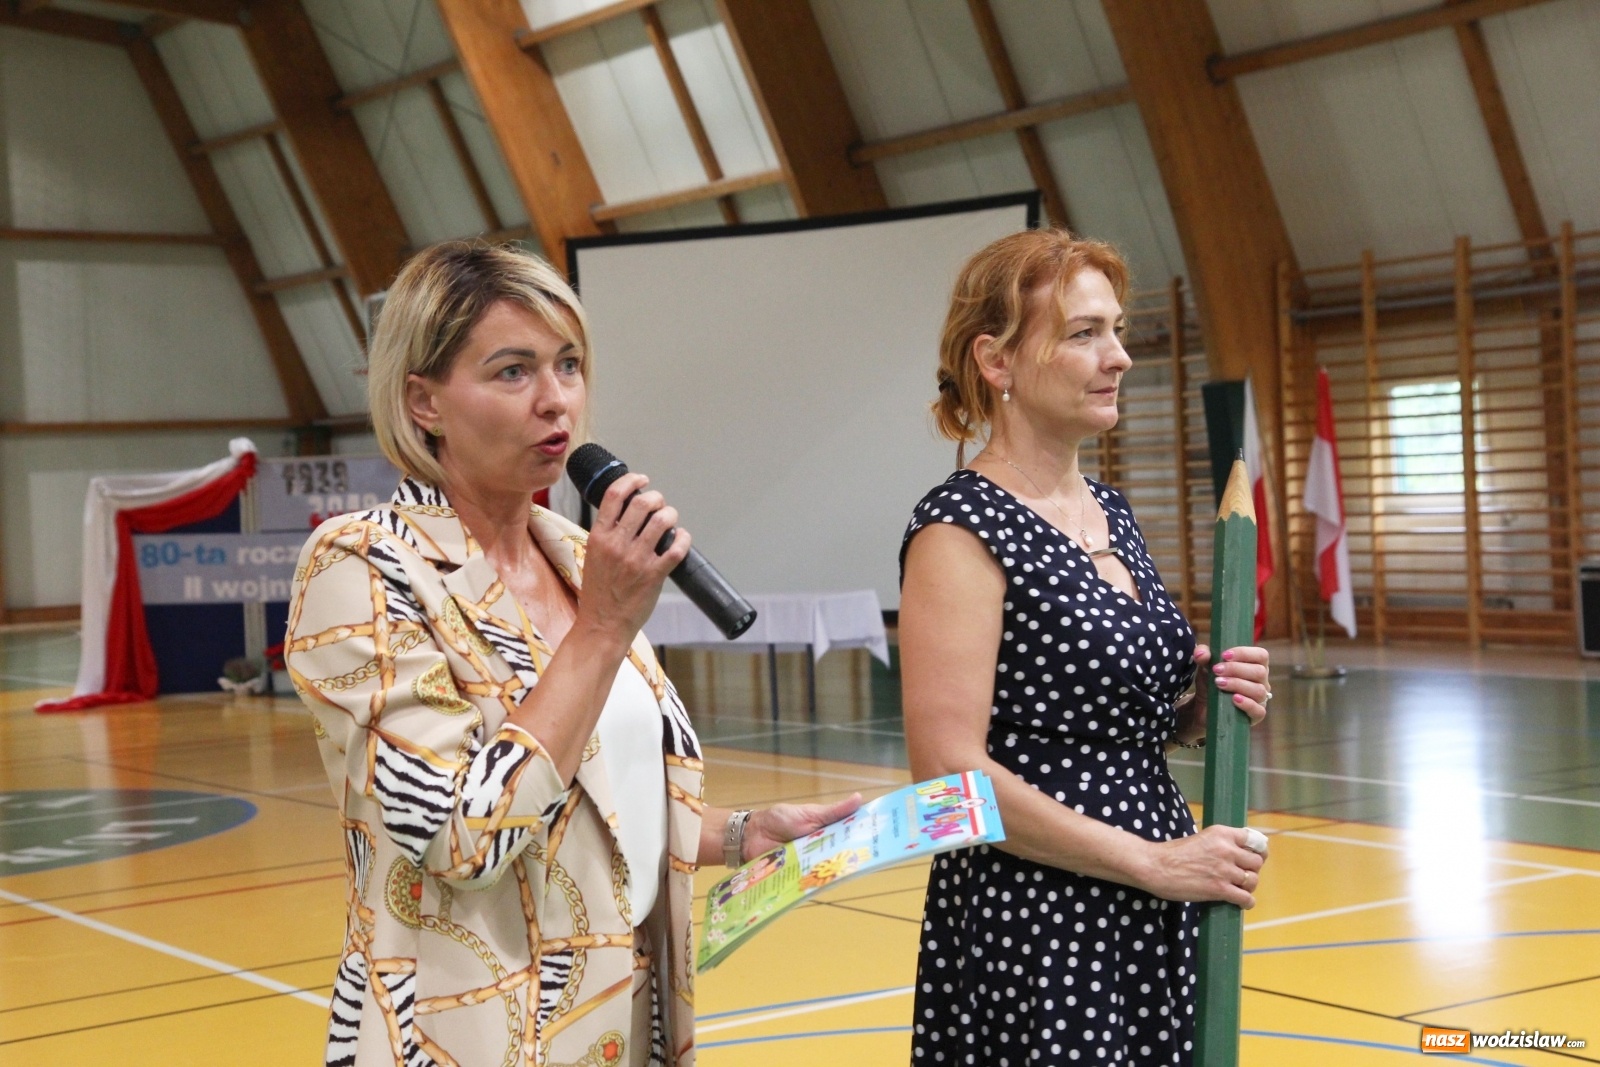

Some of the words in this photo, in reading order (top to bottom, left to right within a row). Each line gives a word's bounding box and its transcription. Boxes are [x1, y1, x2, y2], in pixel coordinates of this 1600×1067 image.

[141, 541, 227, 568] 80-ta
[212, 575, 293, 602] wojn
[916, 781, 967, 841] DYPLOM
